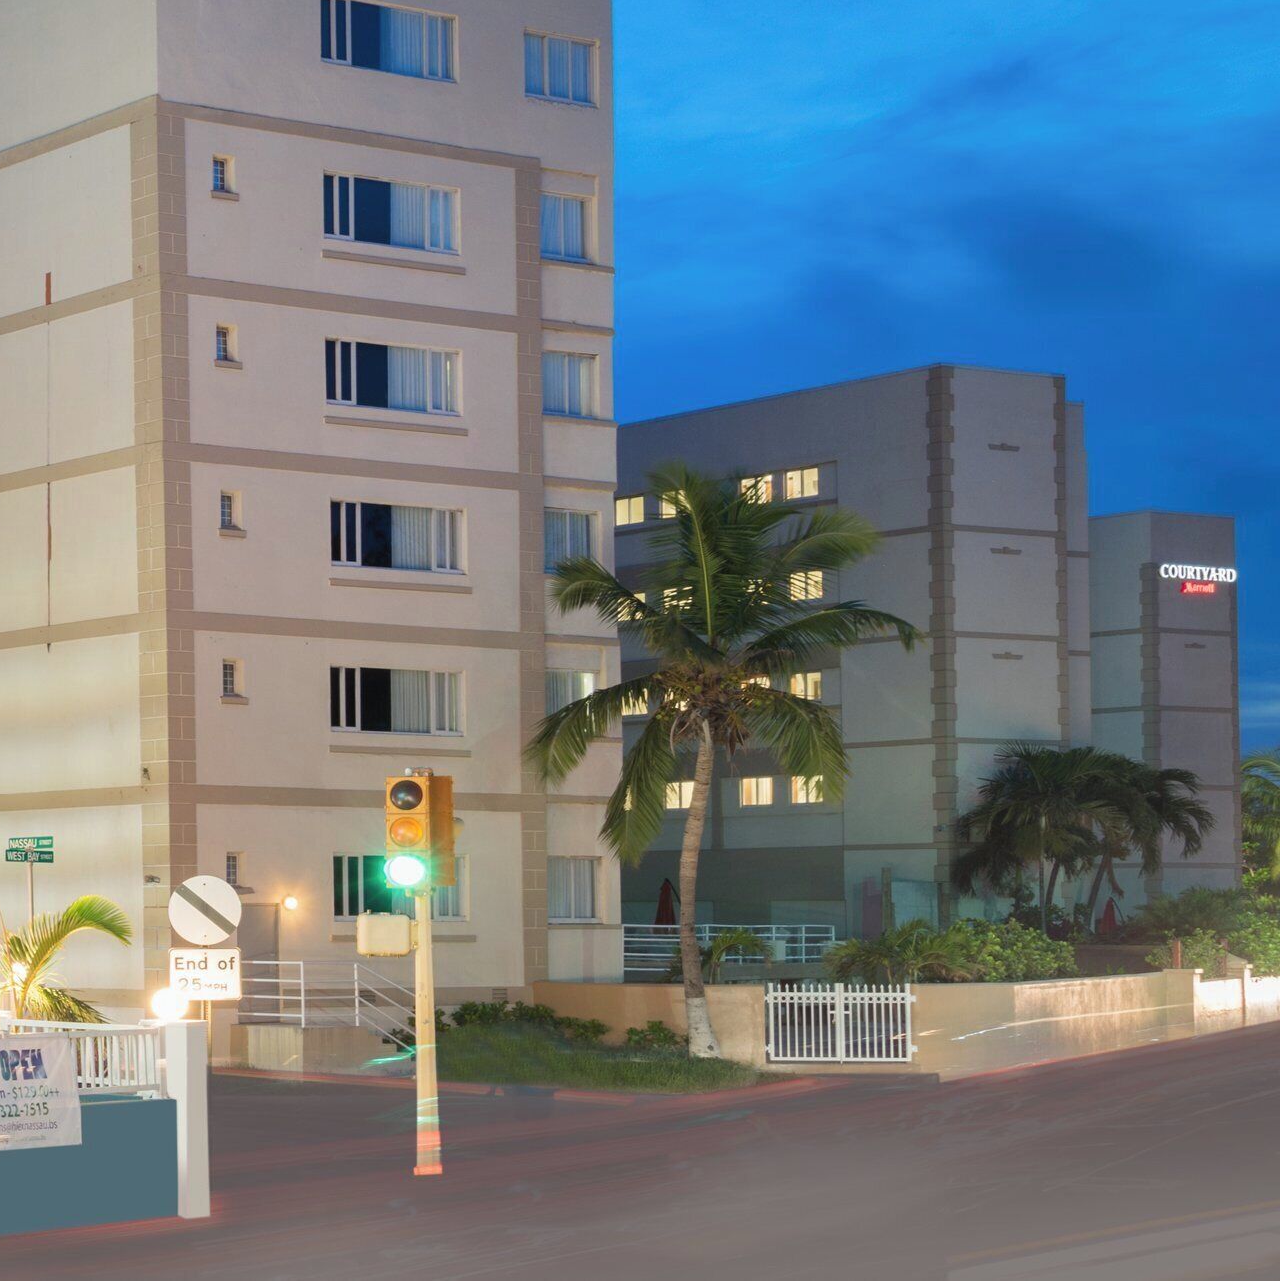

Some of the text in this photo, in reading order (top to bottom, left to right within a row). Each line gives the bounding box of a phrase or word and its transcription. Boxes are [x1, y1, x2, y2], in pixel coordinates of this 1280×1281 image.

[1159, 563, 1237, 583] COURTYARD
[9, 838, 37, 849] NASSAU
[6, 851, 25, 861] WEST
[27, 851, 40, 862] BAY
[174, 956, 236, 971] End of
[0, 1048, 48, 1081] OPEN
